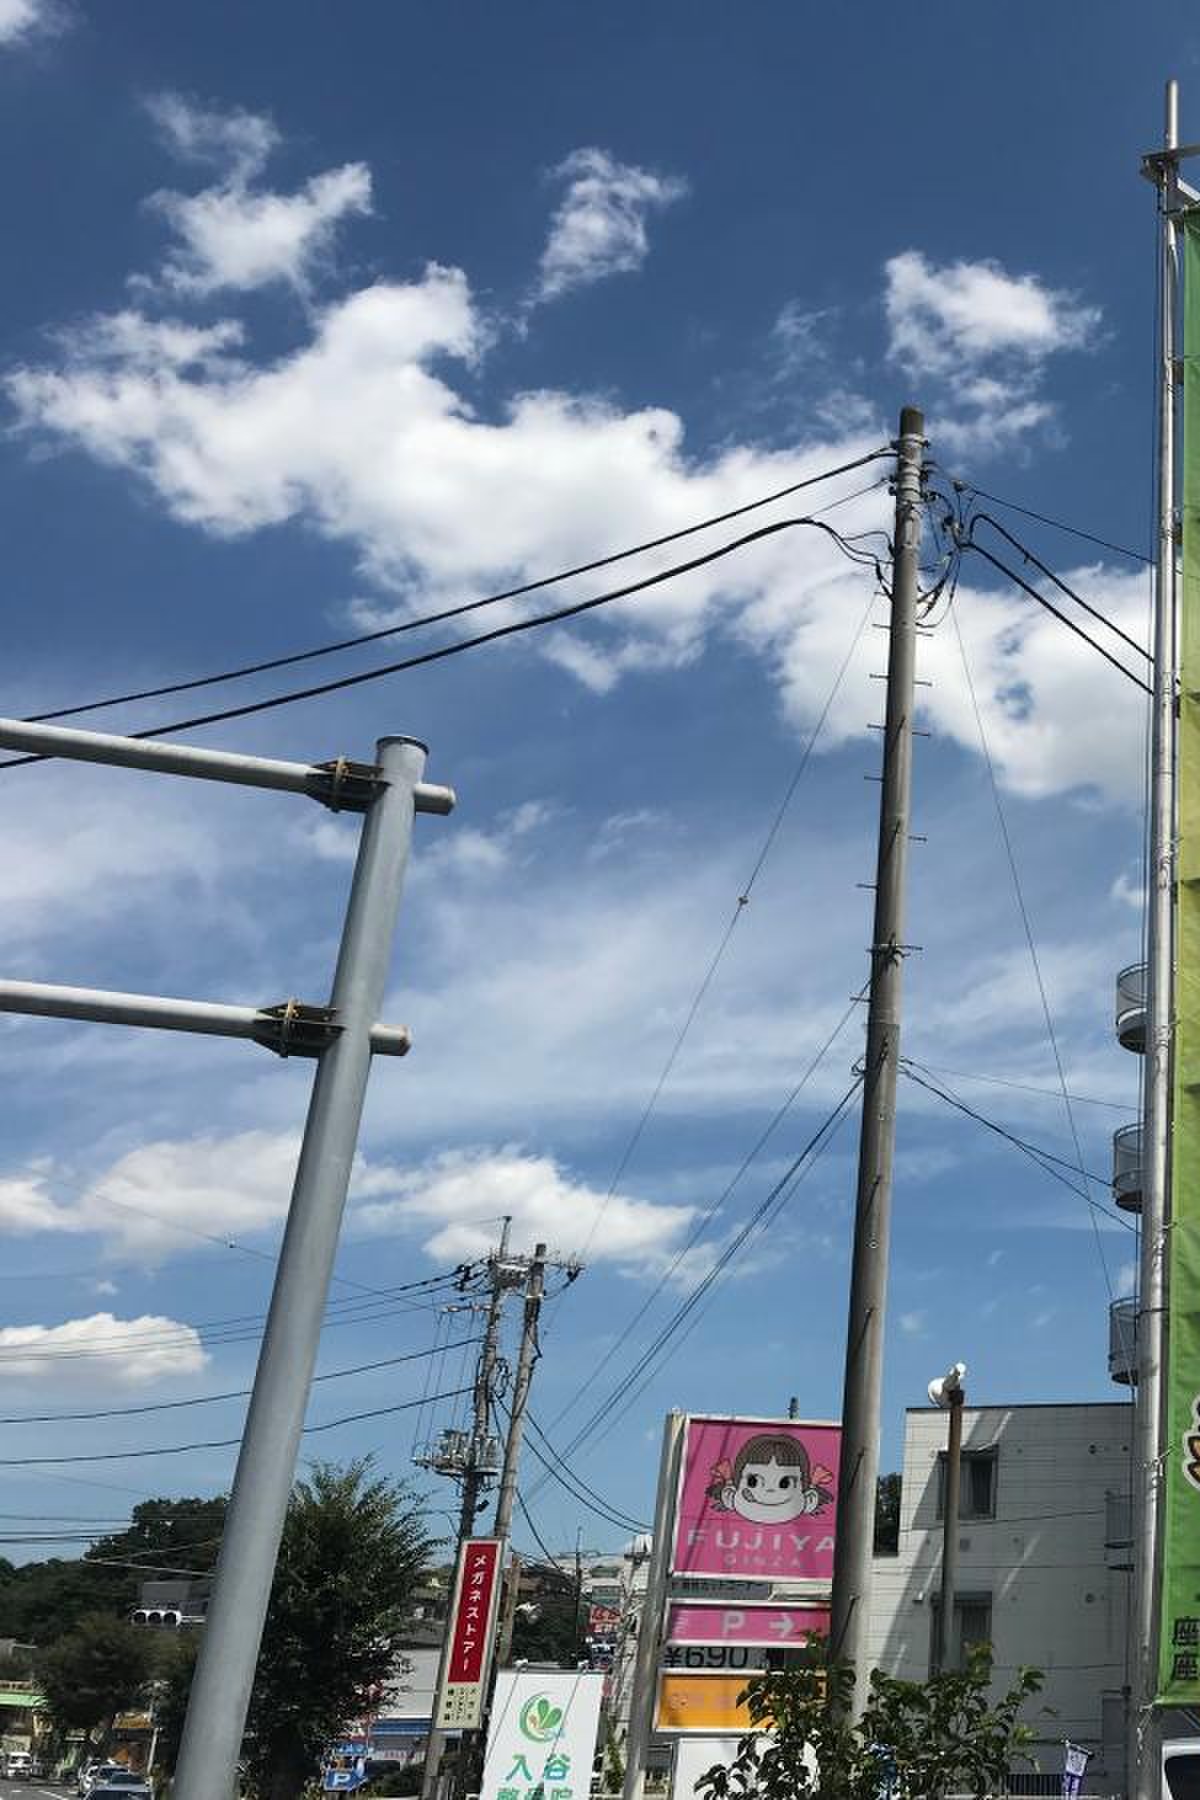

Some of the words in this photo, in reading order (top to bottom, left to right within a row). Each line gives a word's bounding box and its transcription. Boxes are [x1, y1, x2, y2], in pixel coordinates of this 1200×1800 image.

[687, 1529, 836, 1552] FUJIYA
[462, 1554, 488, 1671] メガネストアー
[723, 1611, 745, 1637] P
[333, 1773, 351, 1787] P
[505, 1753, 570, 1781] 入谷
